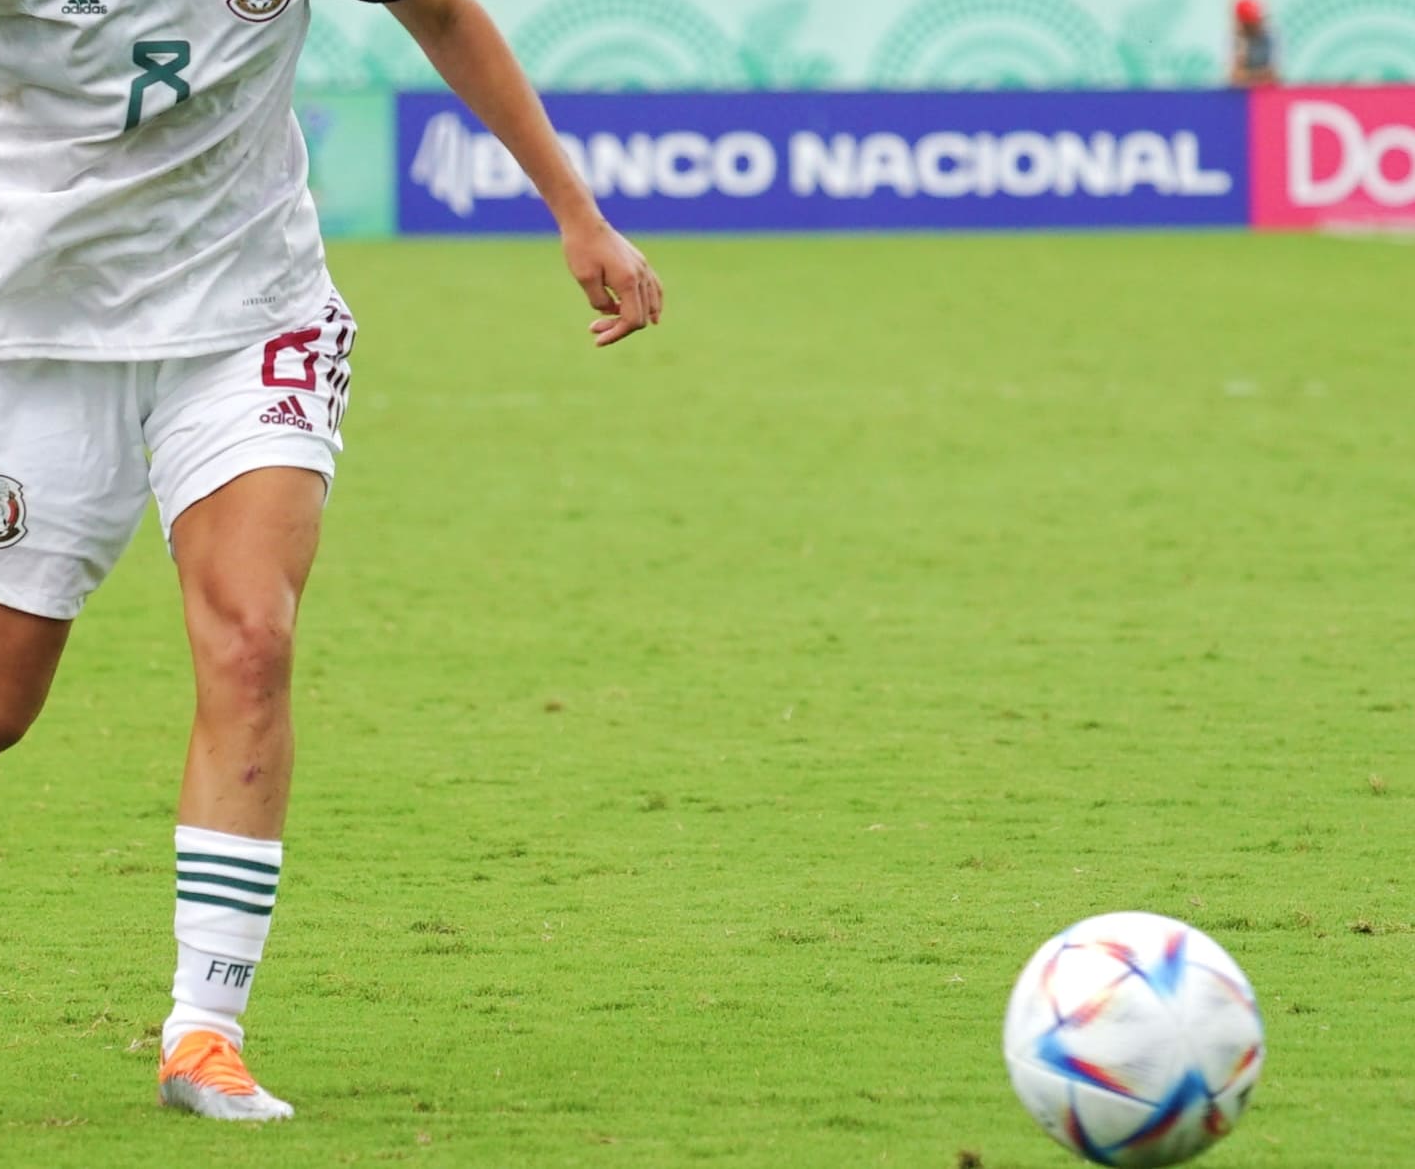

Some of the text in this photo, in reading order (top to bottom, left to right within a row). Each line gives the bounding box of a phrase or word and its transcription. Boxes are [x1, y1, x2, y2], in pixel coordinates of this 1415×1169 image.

[61, 2, 108, 15] adidas
[124, 40, 191, 132] 8
[788, 130, 1233, 198] NACIONAL
[259, 413, 313, 432] adidas
[206, 959, 254, 988] FMF
